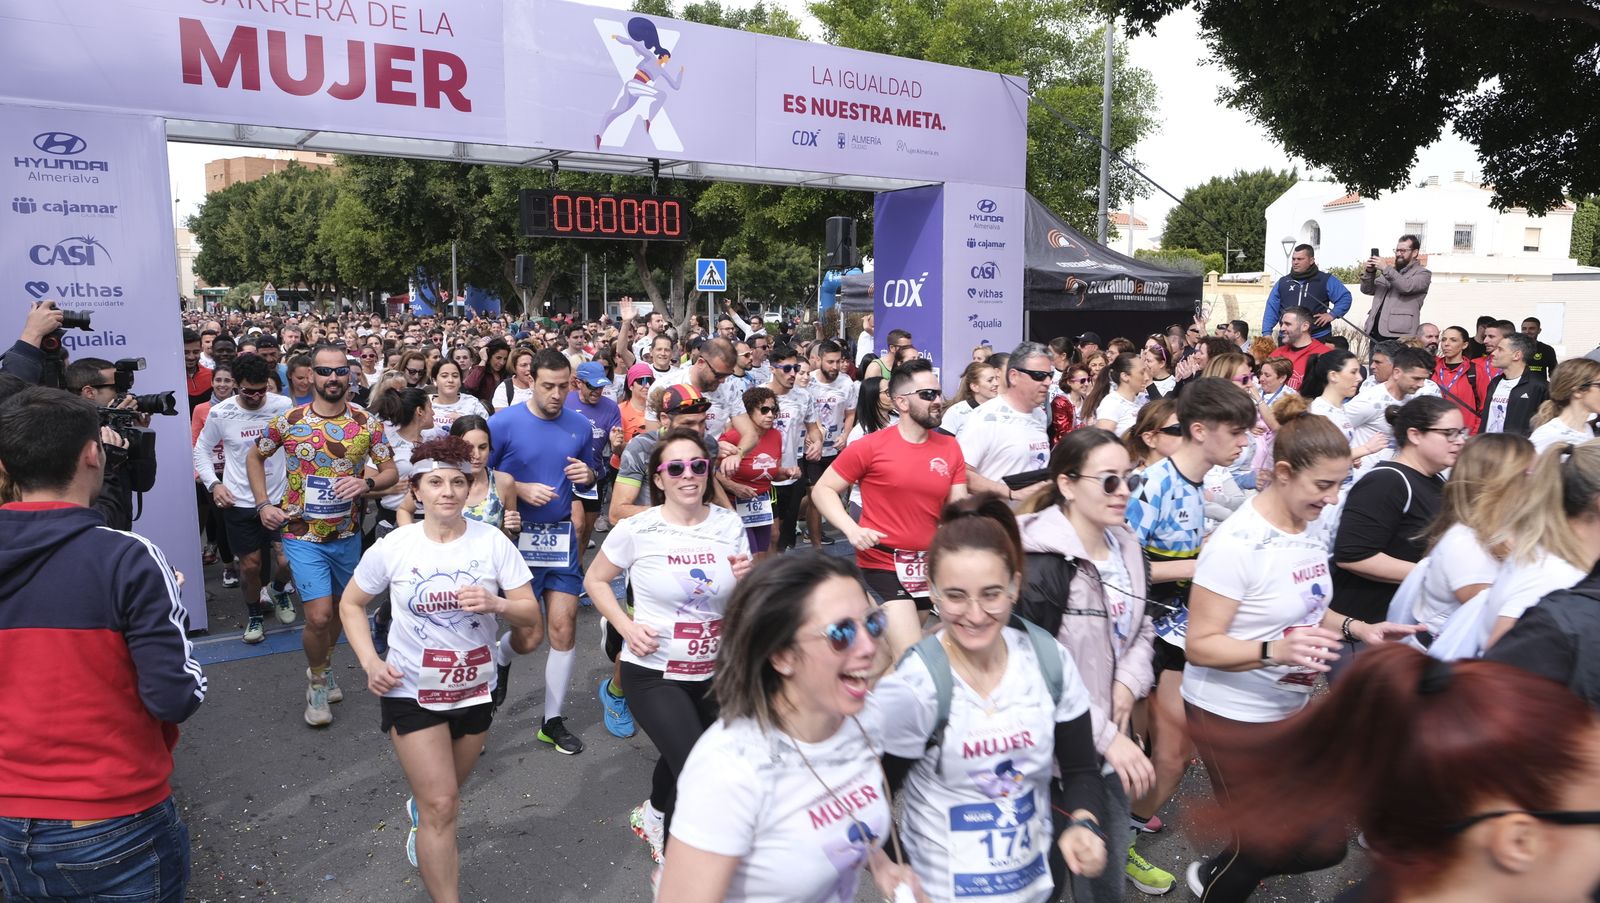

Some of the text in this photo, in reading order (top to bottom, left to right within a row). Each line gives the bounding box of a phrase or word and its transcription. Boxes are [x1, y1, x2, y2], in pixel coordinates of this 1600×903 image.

[200, 0, 455, 37] RERA DE LA
[178, 16, 472, 113] MUJER
[812, 66, 922, 99] LA IGUALDAD
[783, 93, 947, 131] ES NUESTRA META.
[792, 129, 821, 147] CDX
[14, 157, 109, 172] HYUNDAI
[28, 171, 100, 184] Almerialva
[42, 200, 118, 216] cajamar
[553, 195, 680, 235] 00:00:00
[969, 214, 1004, 223] HYUNDAI
[978, 239, 1005, 249] cajamar
[29, 244, 96, 266] CASI
[971, 265, 995, 279] CASI
[56, 282, 123, 298] vithas
[883, 272, 928, 307] CDX
[978, 289, 1004, 299] vithas
[972, 318, 1002, 330] aqualia
[62, 331, 127, 351] qualia
[317, 489, 344, 500] 29
[745, 501, 763, 511] 162
[531, 534, 557, 546] 248
[667, 553, 716, 565] MUJER
[1292, 563, 1328, 585] MUJER
[429, 591, 459, 602] MIN
[416, 601, 462, 613] RUNN
[687, 638, 720, 656] 953
[439, 667, 478, 683] 788
[963, 730, 1036, 760] MUJER
[807, 784, 880, 829] MUJER
